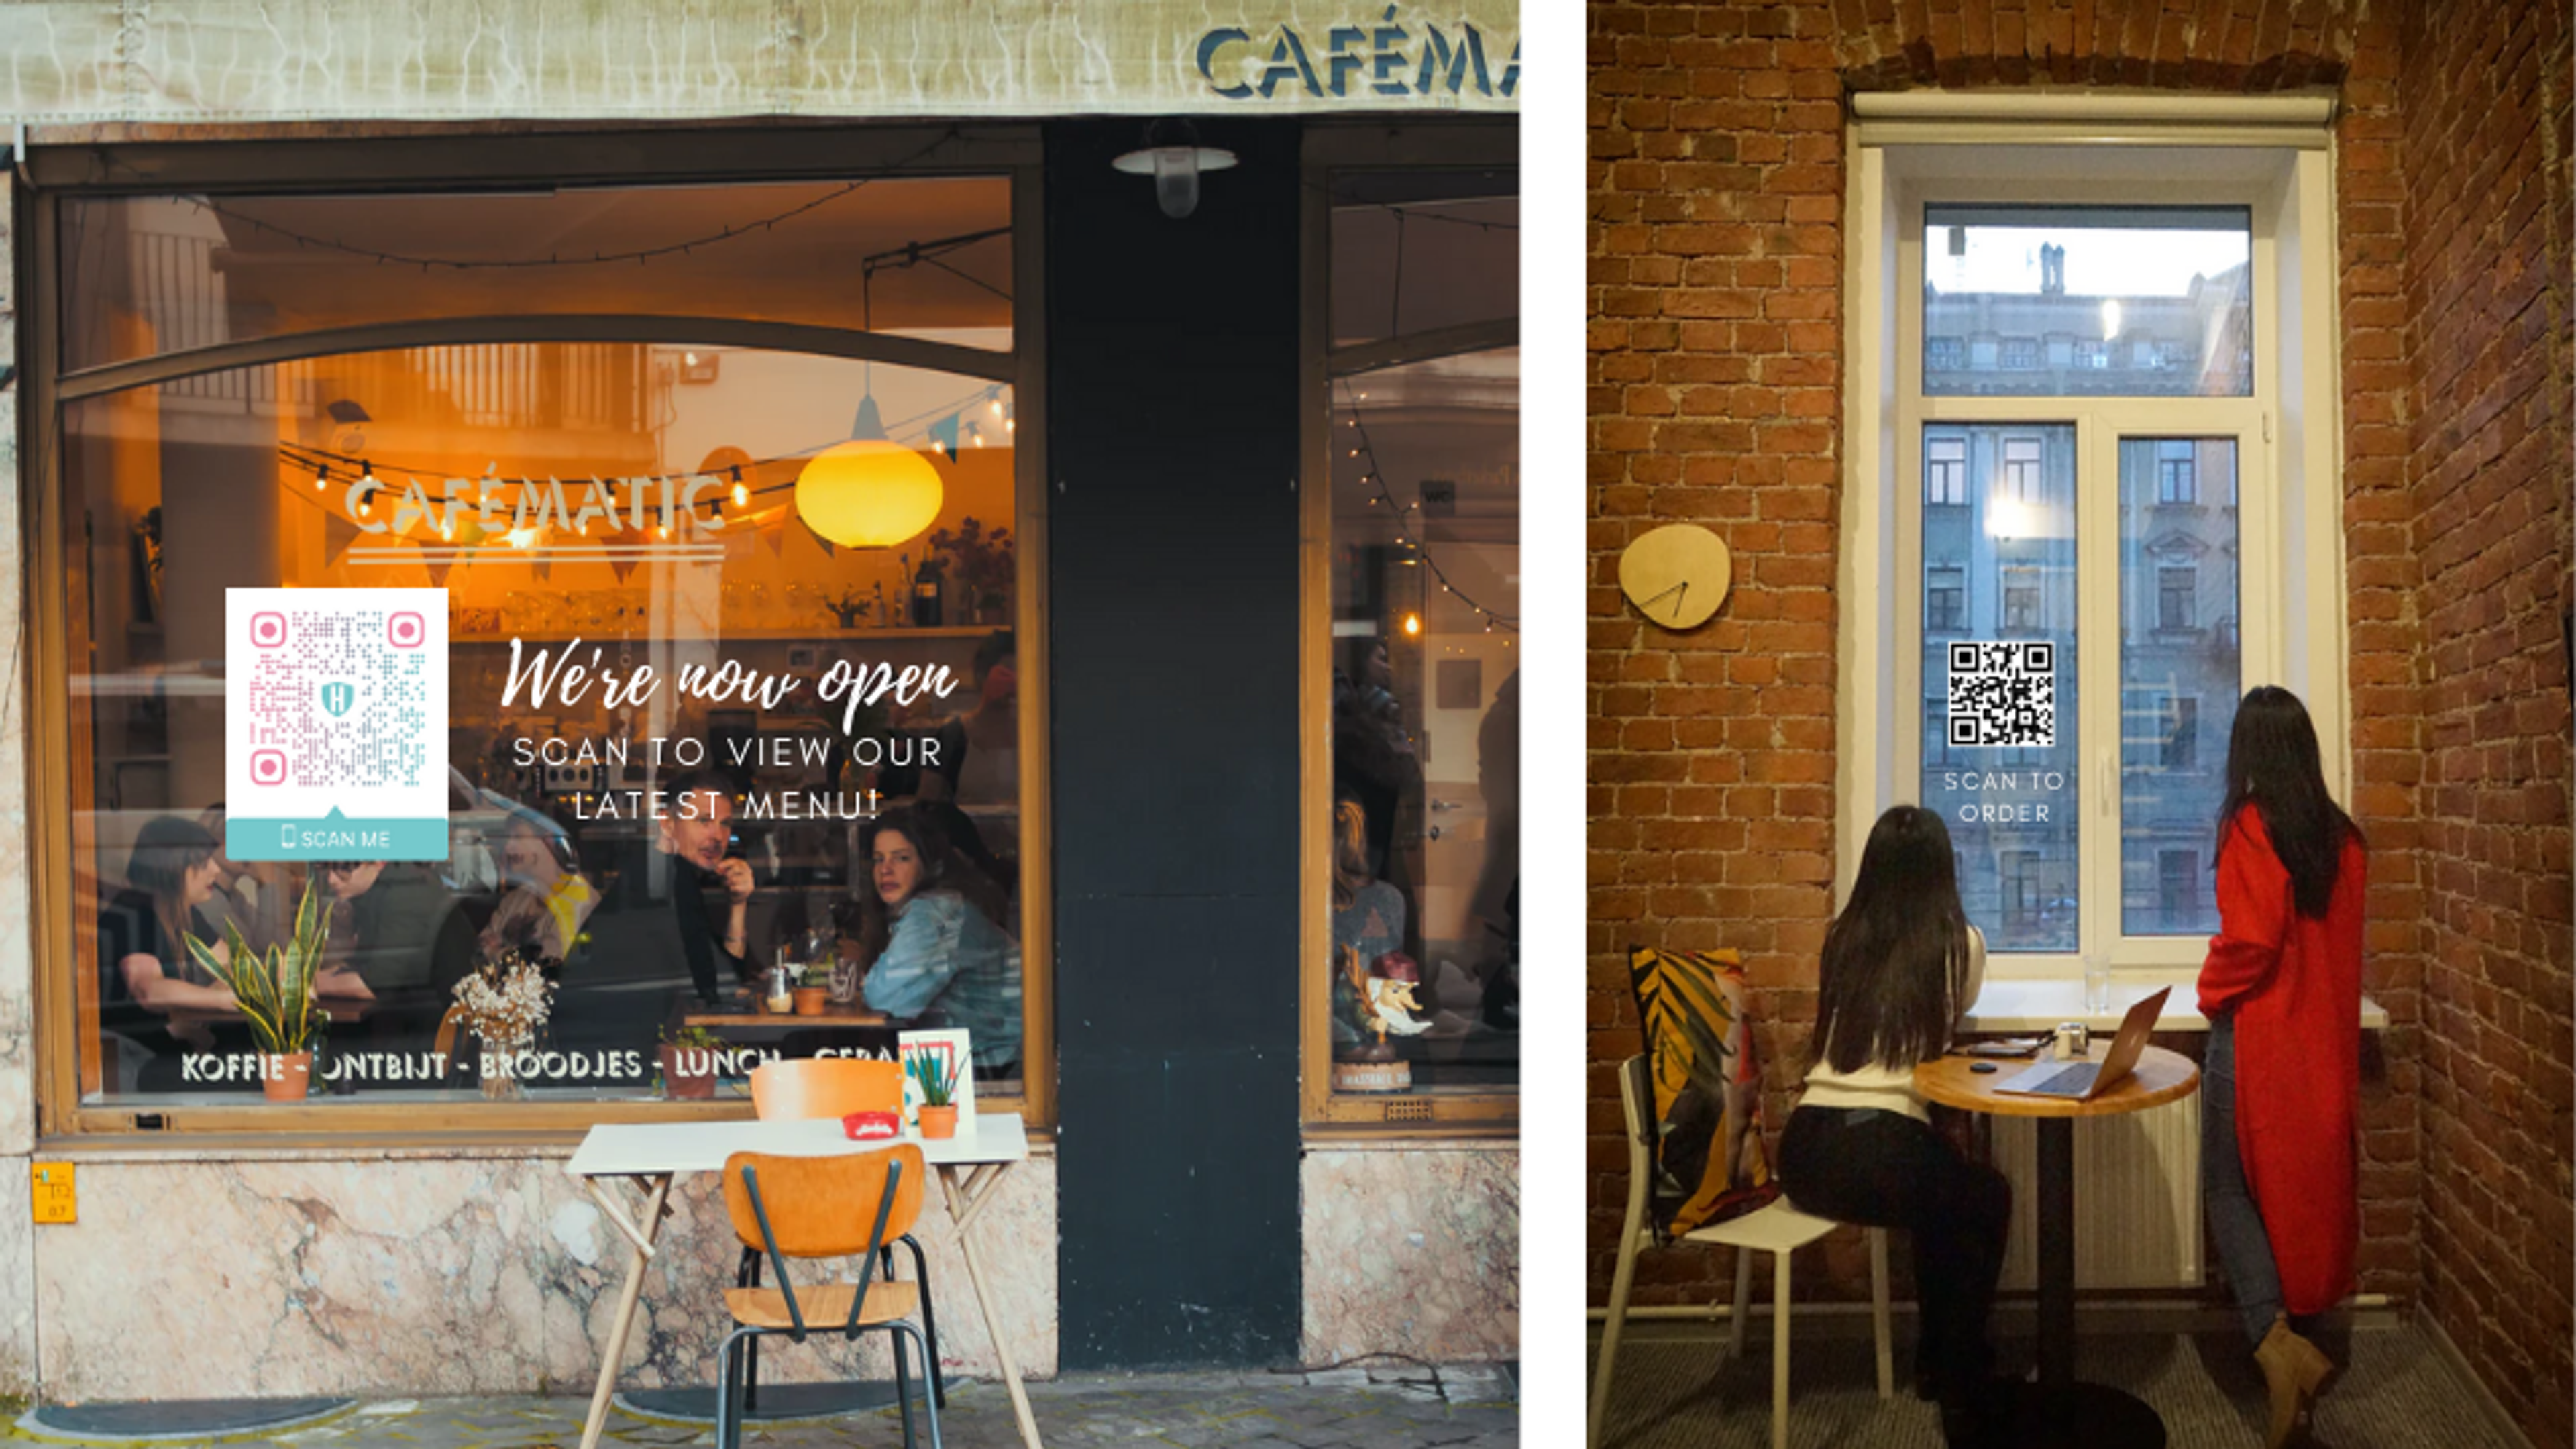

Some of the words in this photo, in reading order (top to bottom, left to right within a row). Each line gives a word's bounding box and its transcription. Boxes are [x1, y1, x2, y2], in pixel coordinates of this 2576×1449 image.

[345, 461, 725, 533] CAFÉMATIC
[182, 1053, 284, 1081] KOFFIE
[480, 1050, 643, 1079] BROODJES
